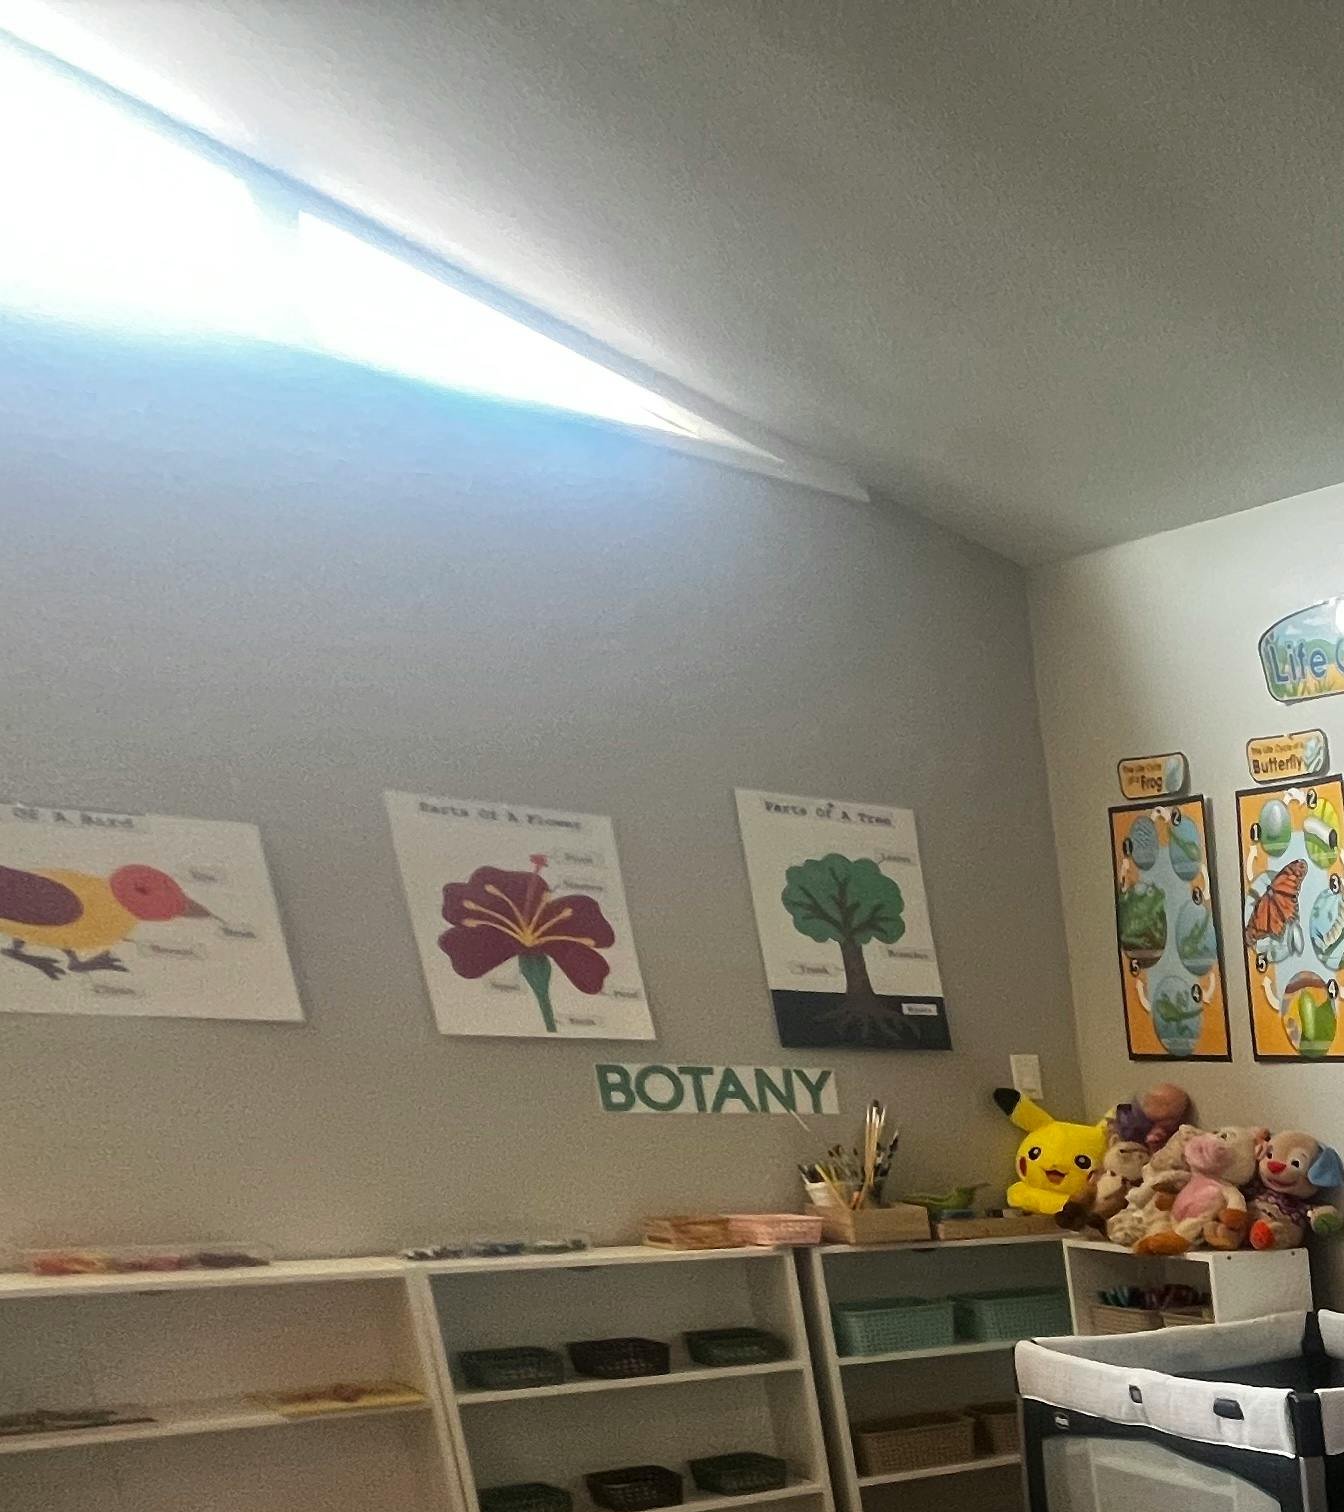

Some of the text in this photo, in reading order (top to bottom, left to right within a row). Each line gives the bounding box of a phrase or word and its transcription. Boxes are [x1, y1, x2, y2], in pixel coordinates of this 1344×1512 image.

[1268, 641, 1327, 682] Life
[1252, 753, 1304, 774] Butterfly
[1140, 774, 1163, 793] Frog
[764, 801, 808, 816] Parts
[857, 812, 893, 826] Tree
[595, 1064, 833, 1113] BOTANY
